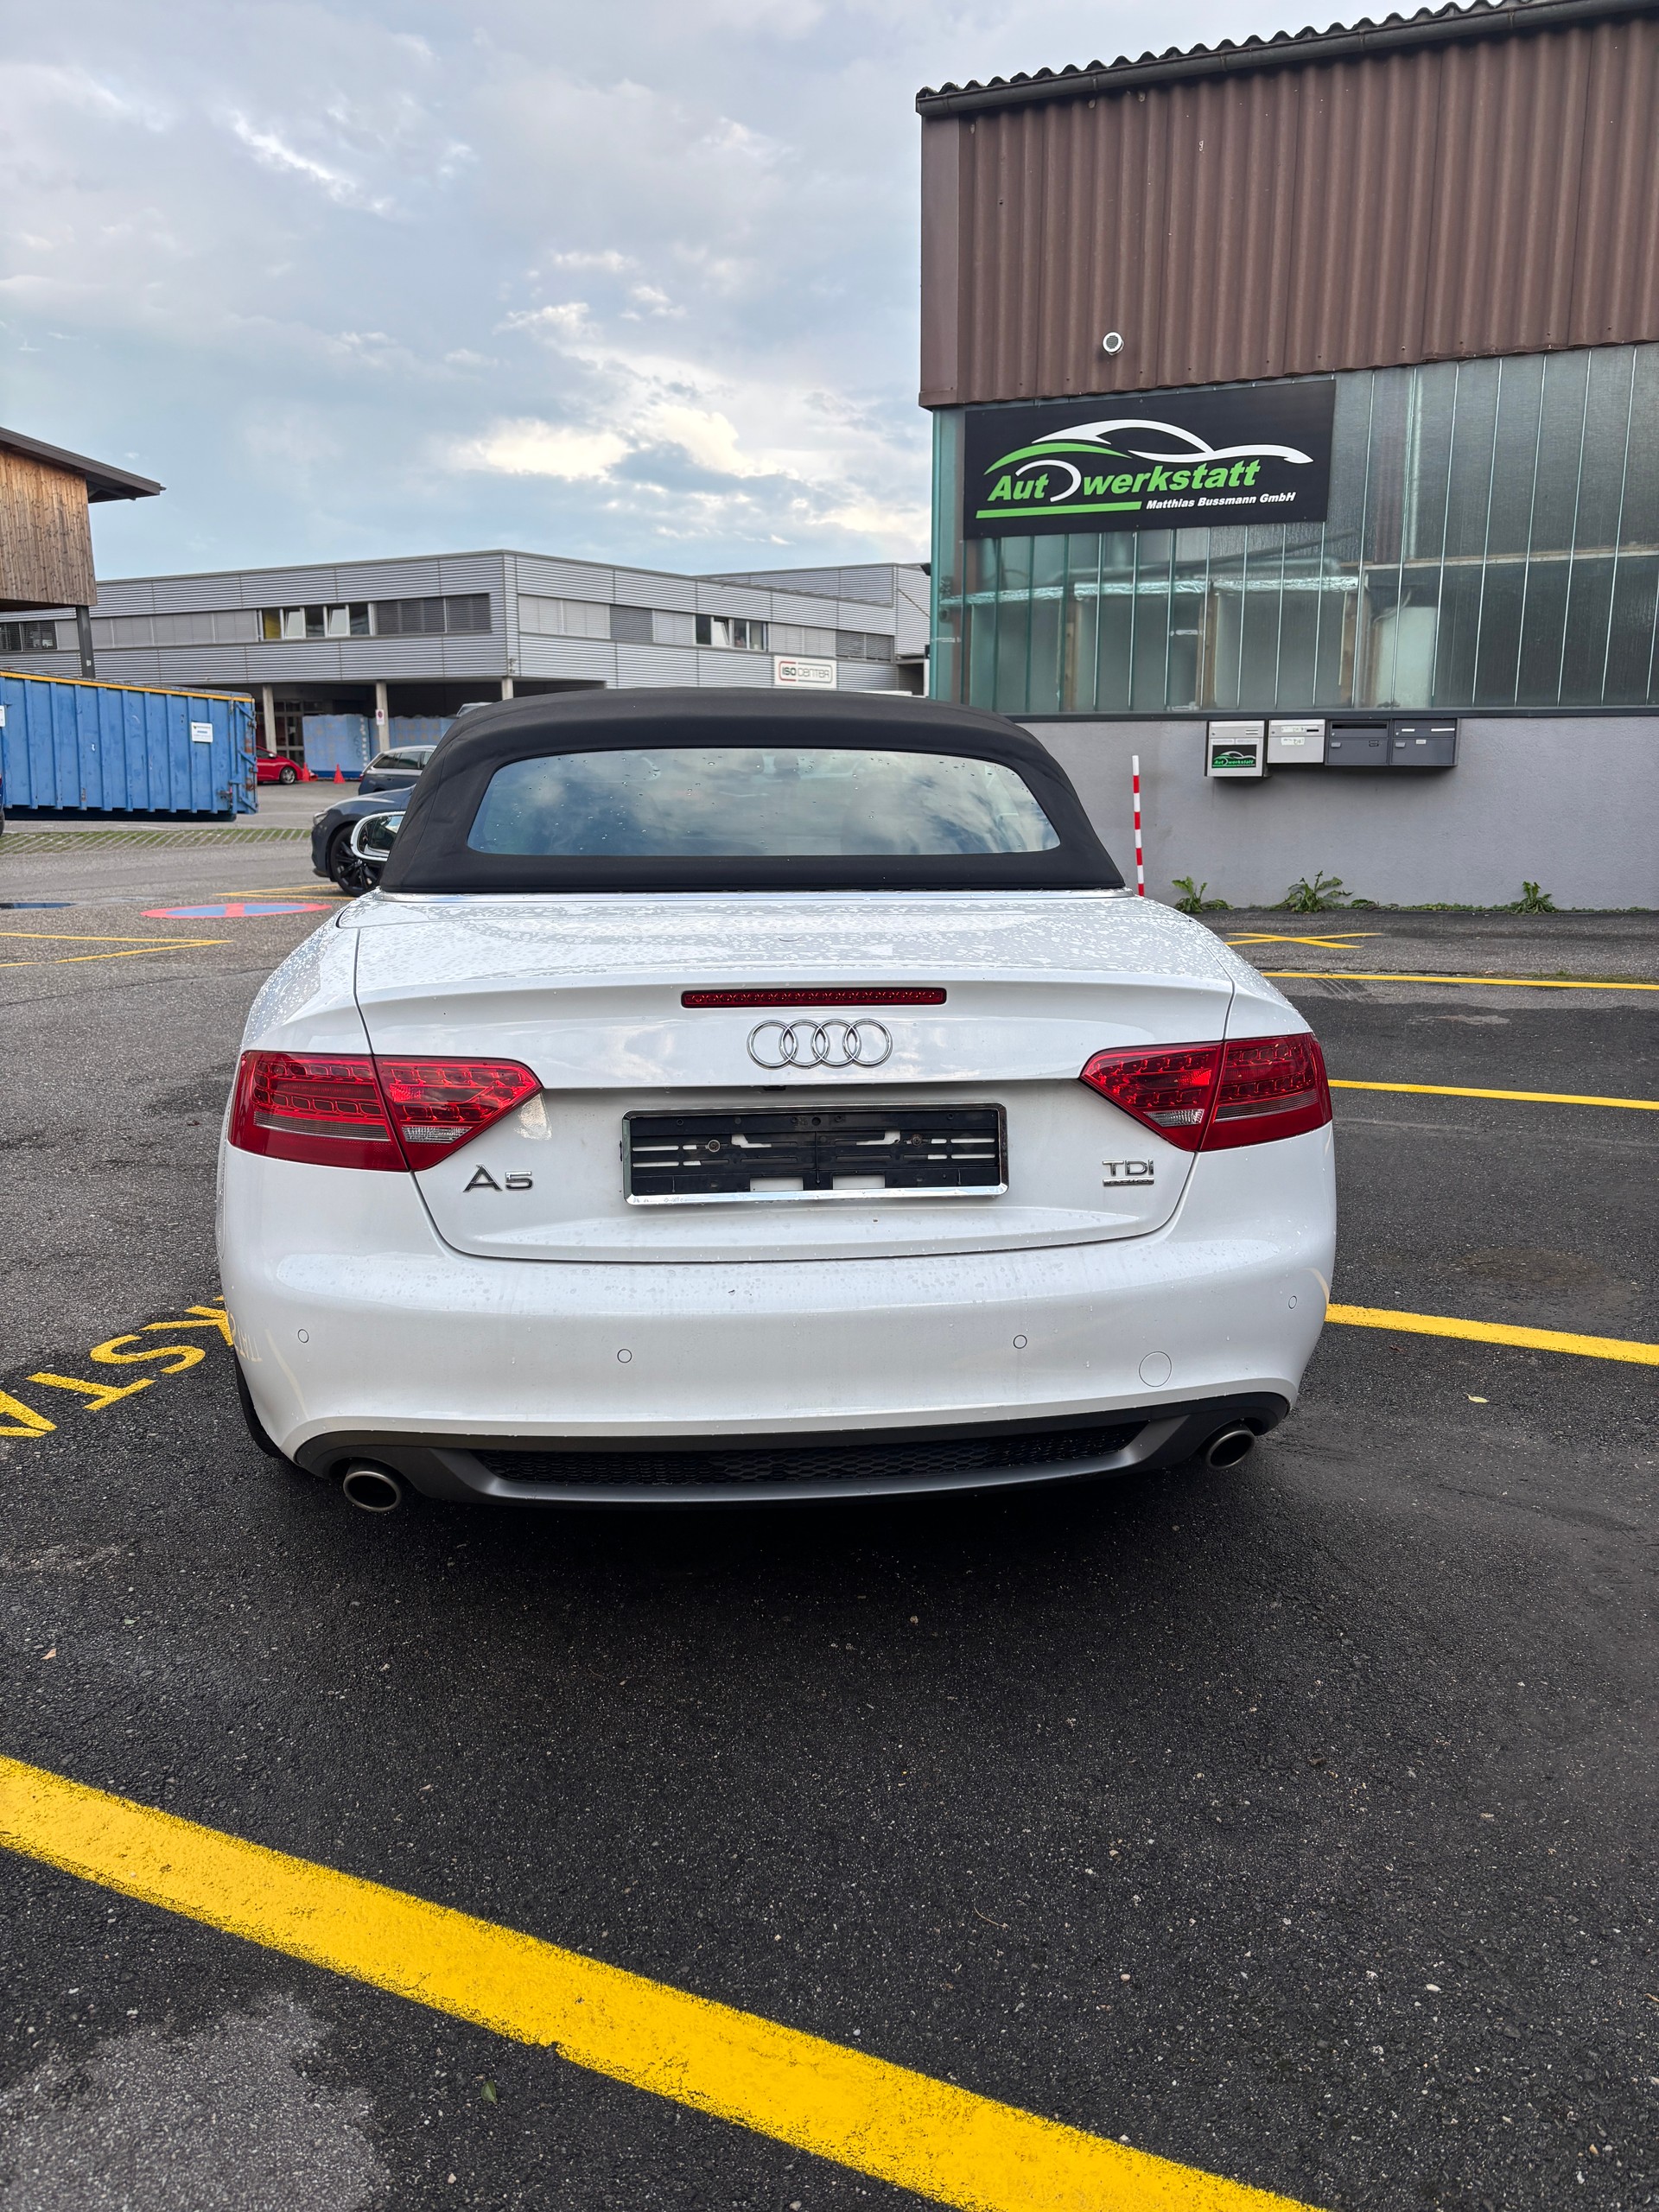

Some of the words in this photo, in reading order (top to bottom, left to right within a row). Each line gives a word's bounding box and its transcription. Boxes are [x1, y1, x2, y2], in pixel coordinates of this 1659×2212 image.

[1146, 498, 1194, 510] Matthias
[1197, 495, 1256, 507] Bussmann
[1259, 492, 1296, 503] GmbH
[782, 667, 797, 676] ISO
[1103, 1159, 1154, 1176] TDI
[462, 1163, 534, 1193] A5
